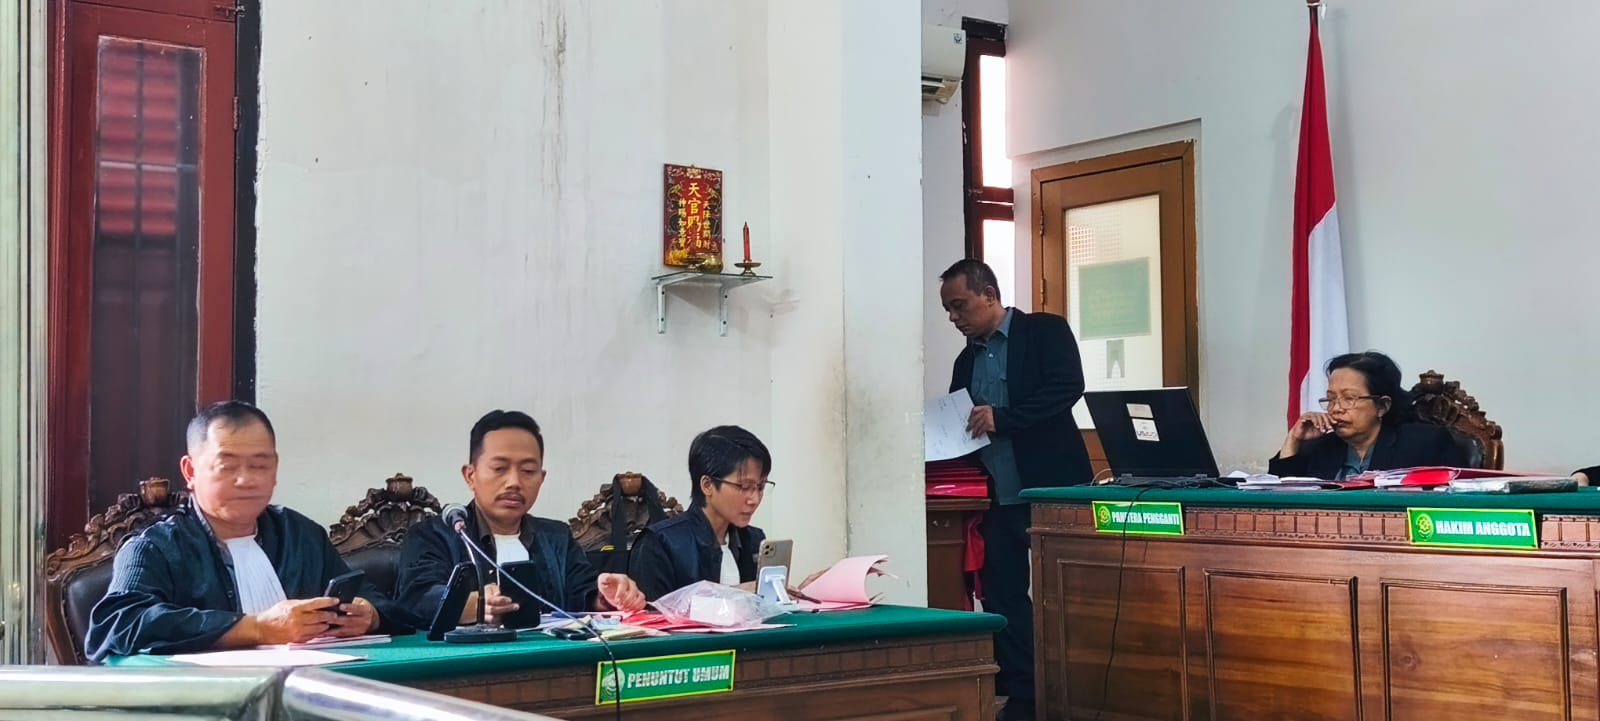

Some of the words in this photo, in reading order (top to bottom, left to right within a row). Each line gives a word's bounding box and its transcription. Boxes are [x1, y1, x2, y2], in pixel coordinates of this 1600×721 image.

[1143, 512, 1179, 525] PENGGANTI
[1435, 520, 1474, 535] HAKIM
[1475, 521, 1531, 537] ANGGOTA
[627, 668, 690, 688] PENUNTUT
[692, 664, 730, 682] UMUM
